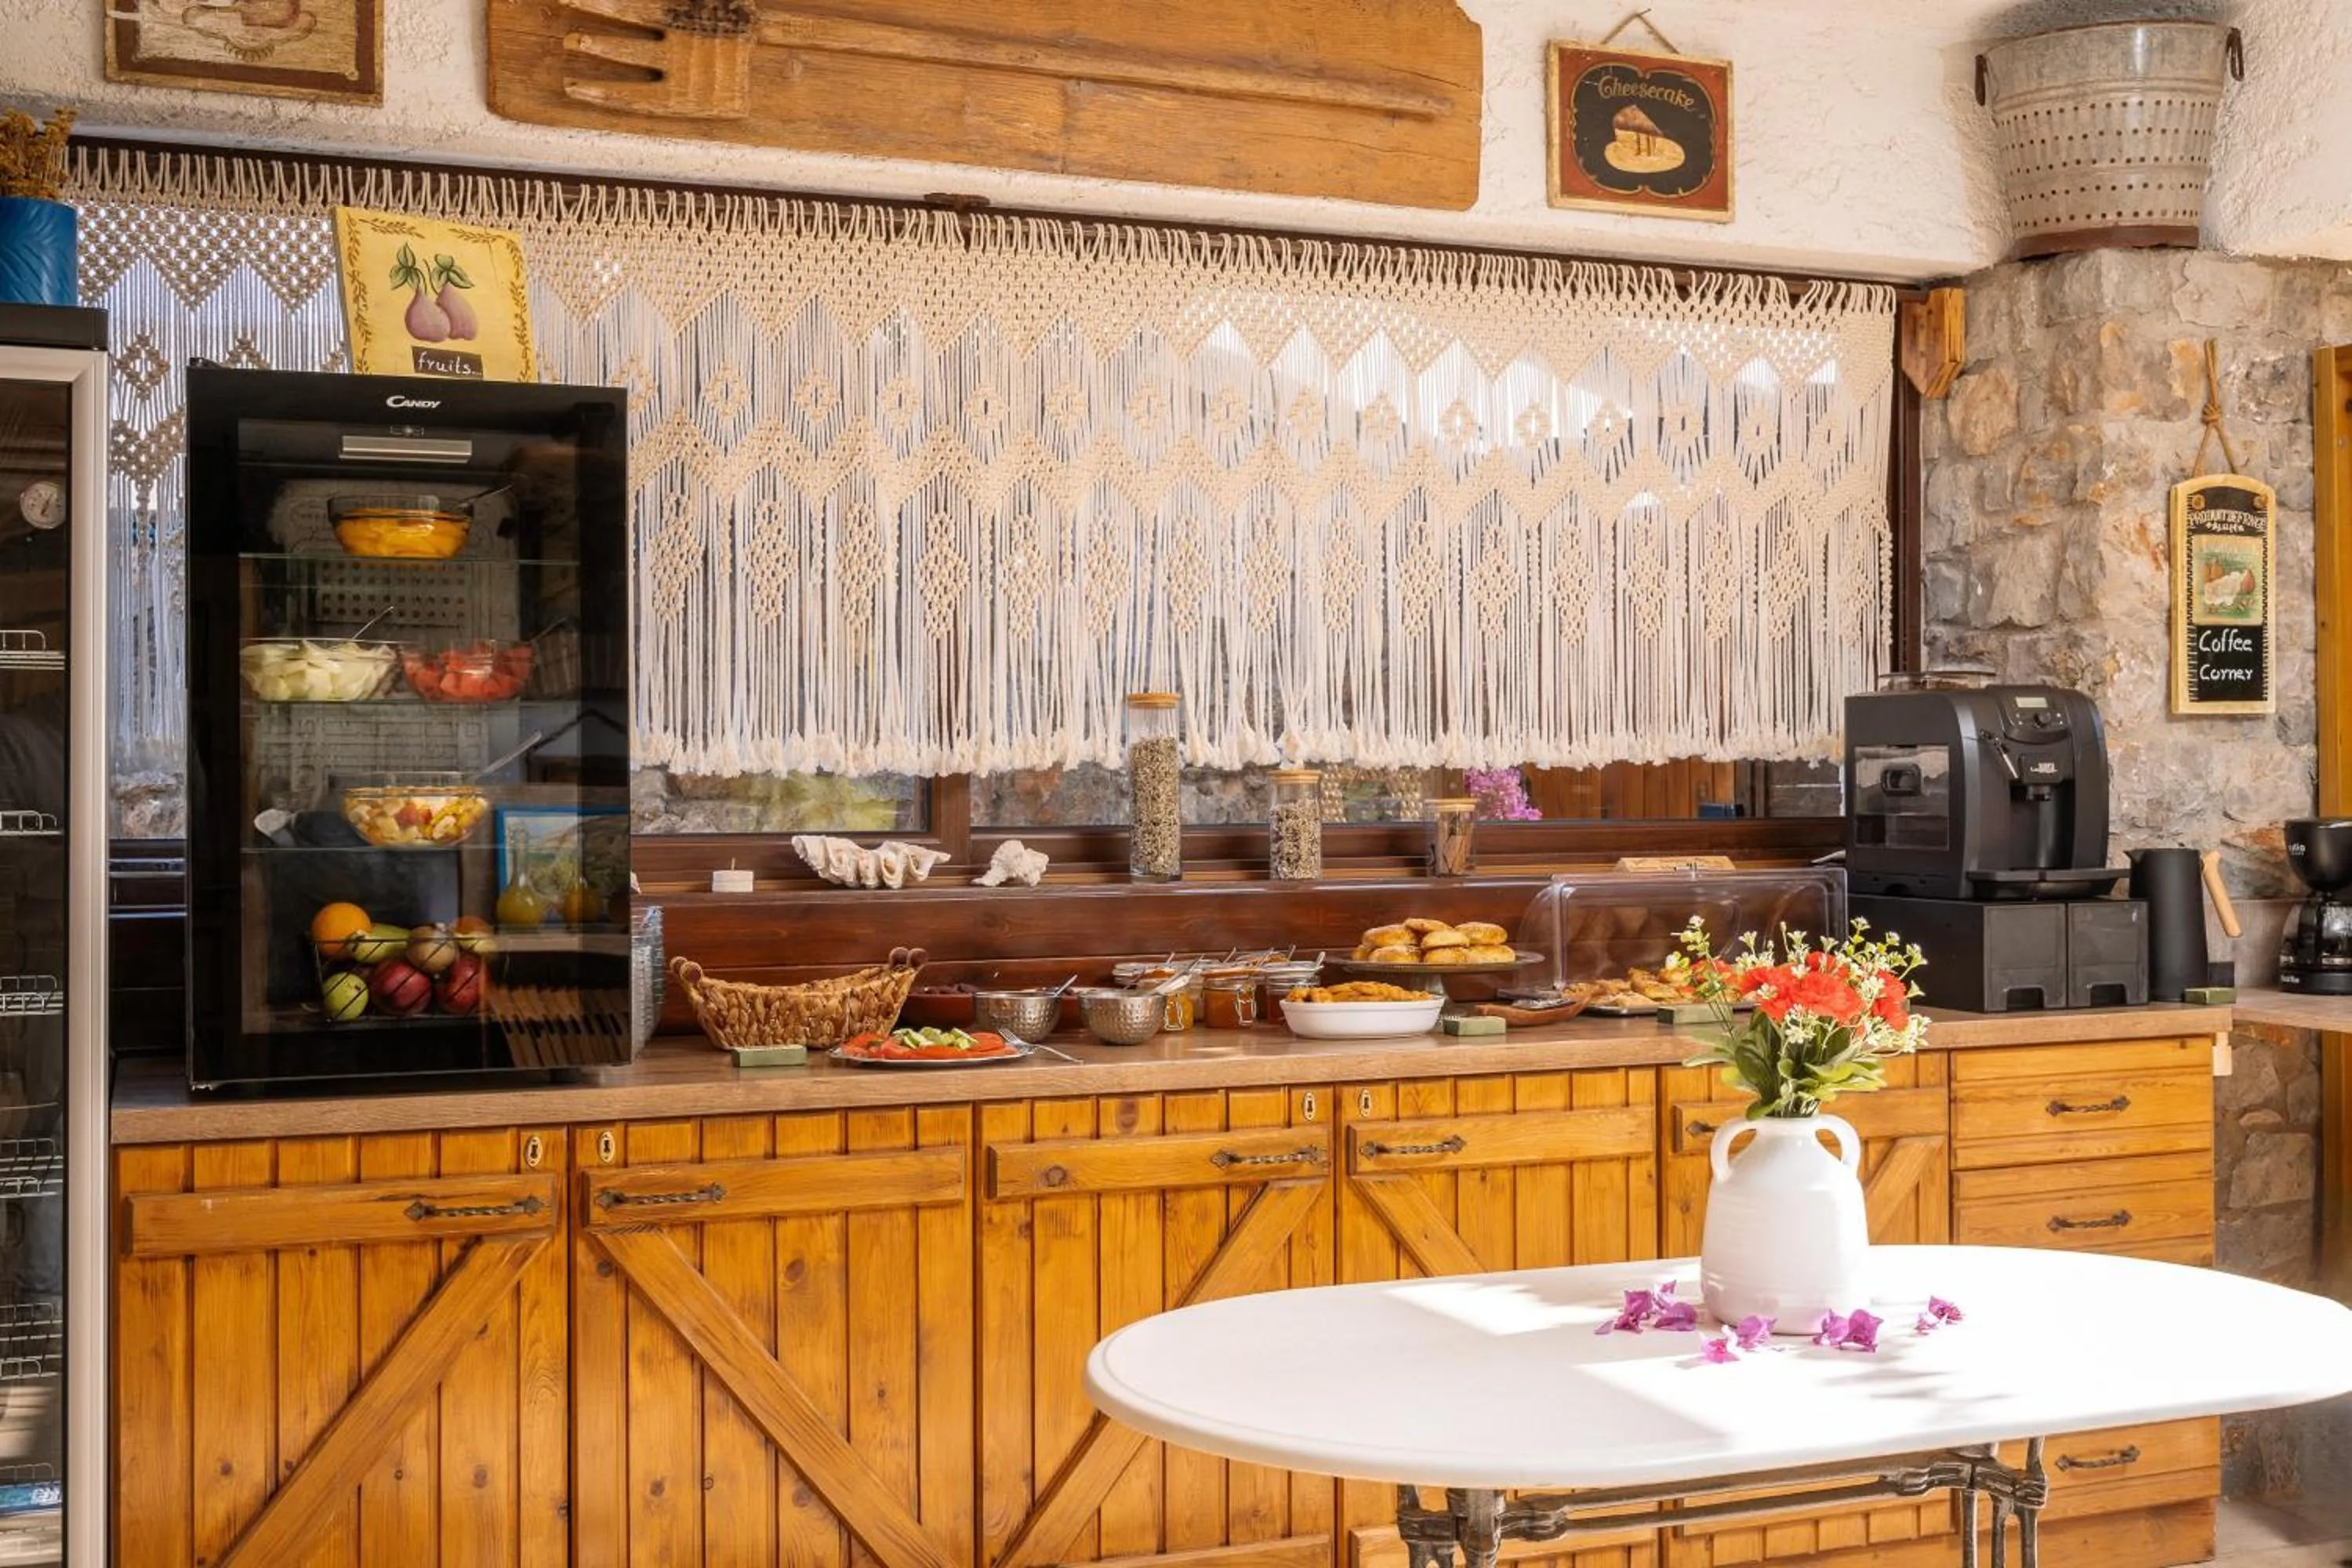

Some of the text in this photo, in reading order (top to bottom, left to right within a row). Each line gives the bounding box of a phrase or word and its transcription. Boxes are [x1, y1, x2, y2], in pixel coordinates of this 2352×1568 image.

[1599, 75, 1694, 111] Cheesecake
[2199, 628, 2252, 652] Coffee
[2199, 663, 2253, 681] Corner
